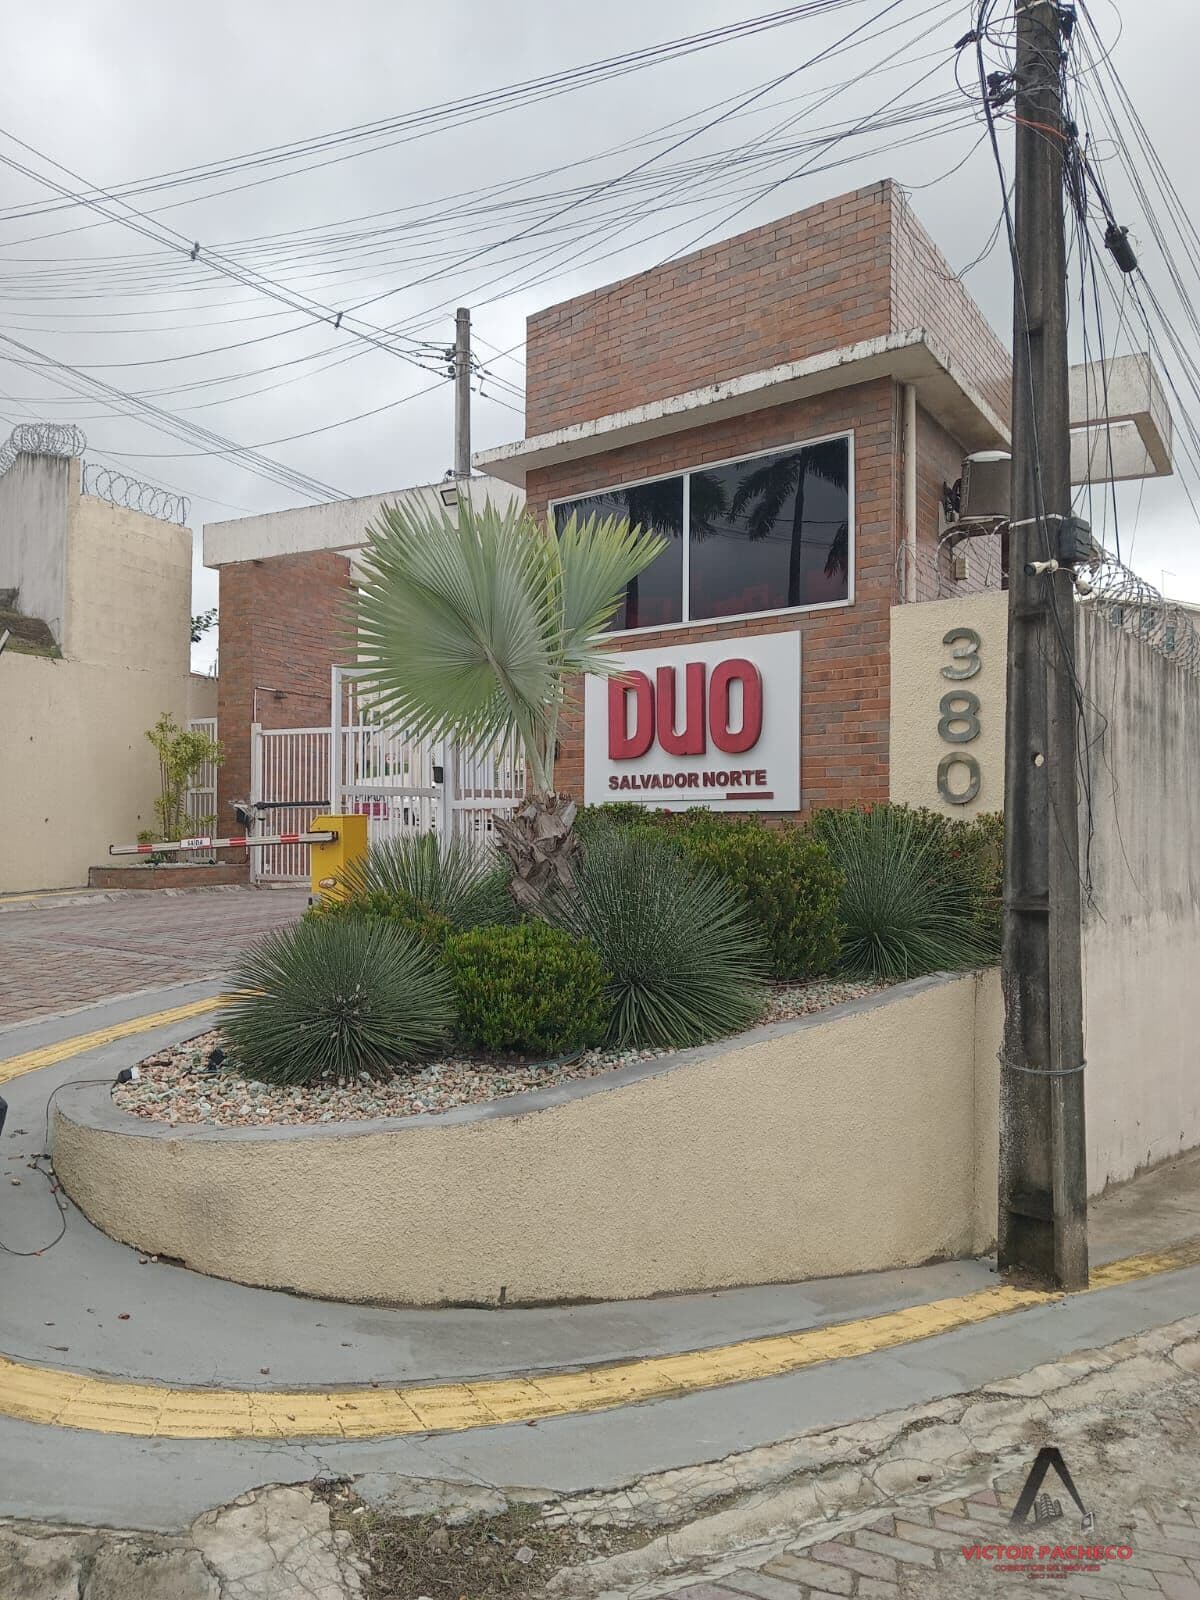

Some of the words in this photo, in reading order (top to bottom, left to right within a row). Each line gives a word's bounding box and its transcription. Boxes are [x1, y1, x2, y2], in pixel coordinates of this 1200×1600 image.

[608, 658, 764, 760] DUO
[936, 627, 982, 804] 380
[609, 773, 700, 790] SALVADOR
[702, 769, 767, 787] NORTE
